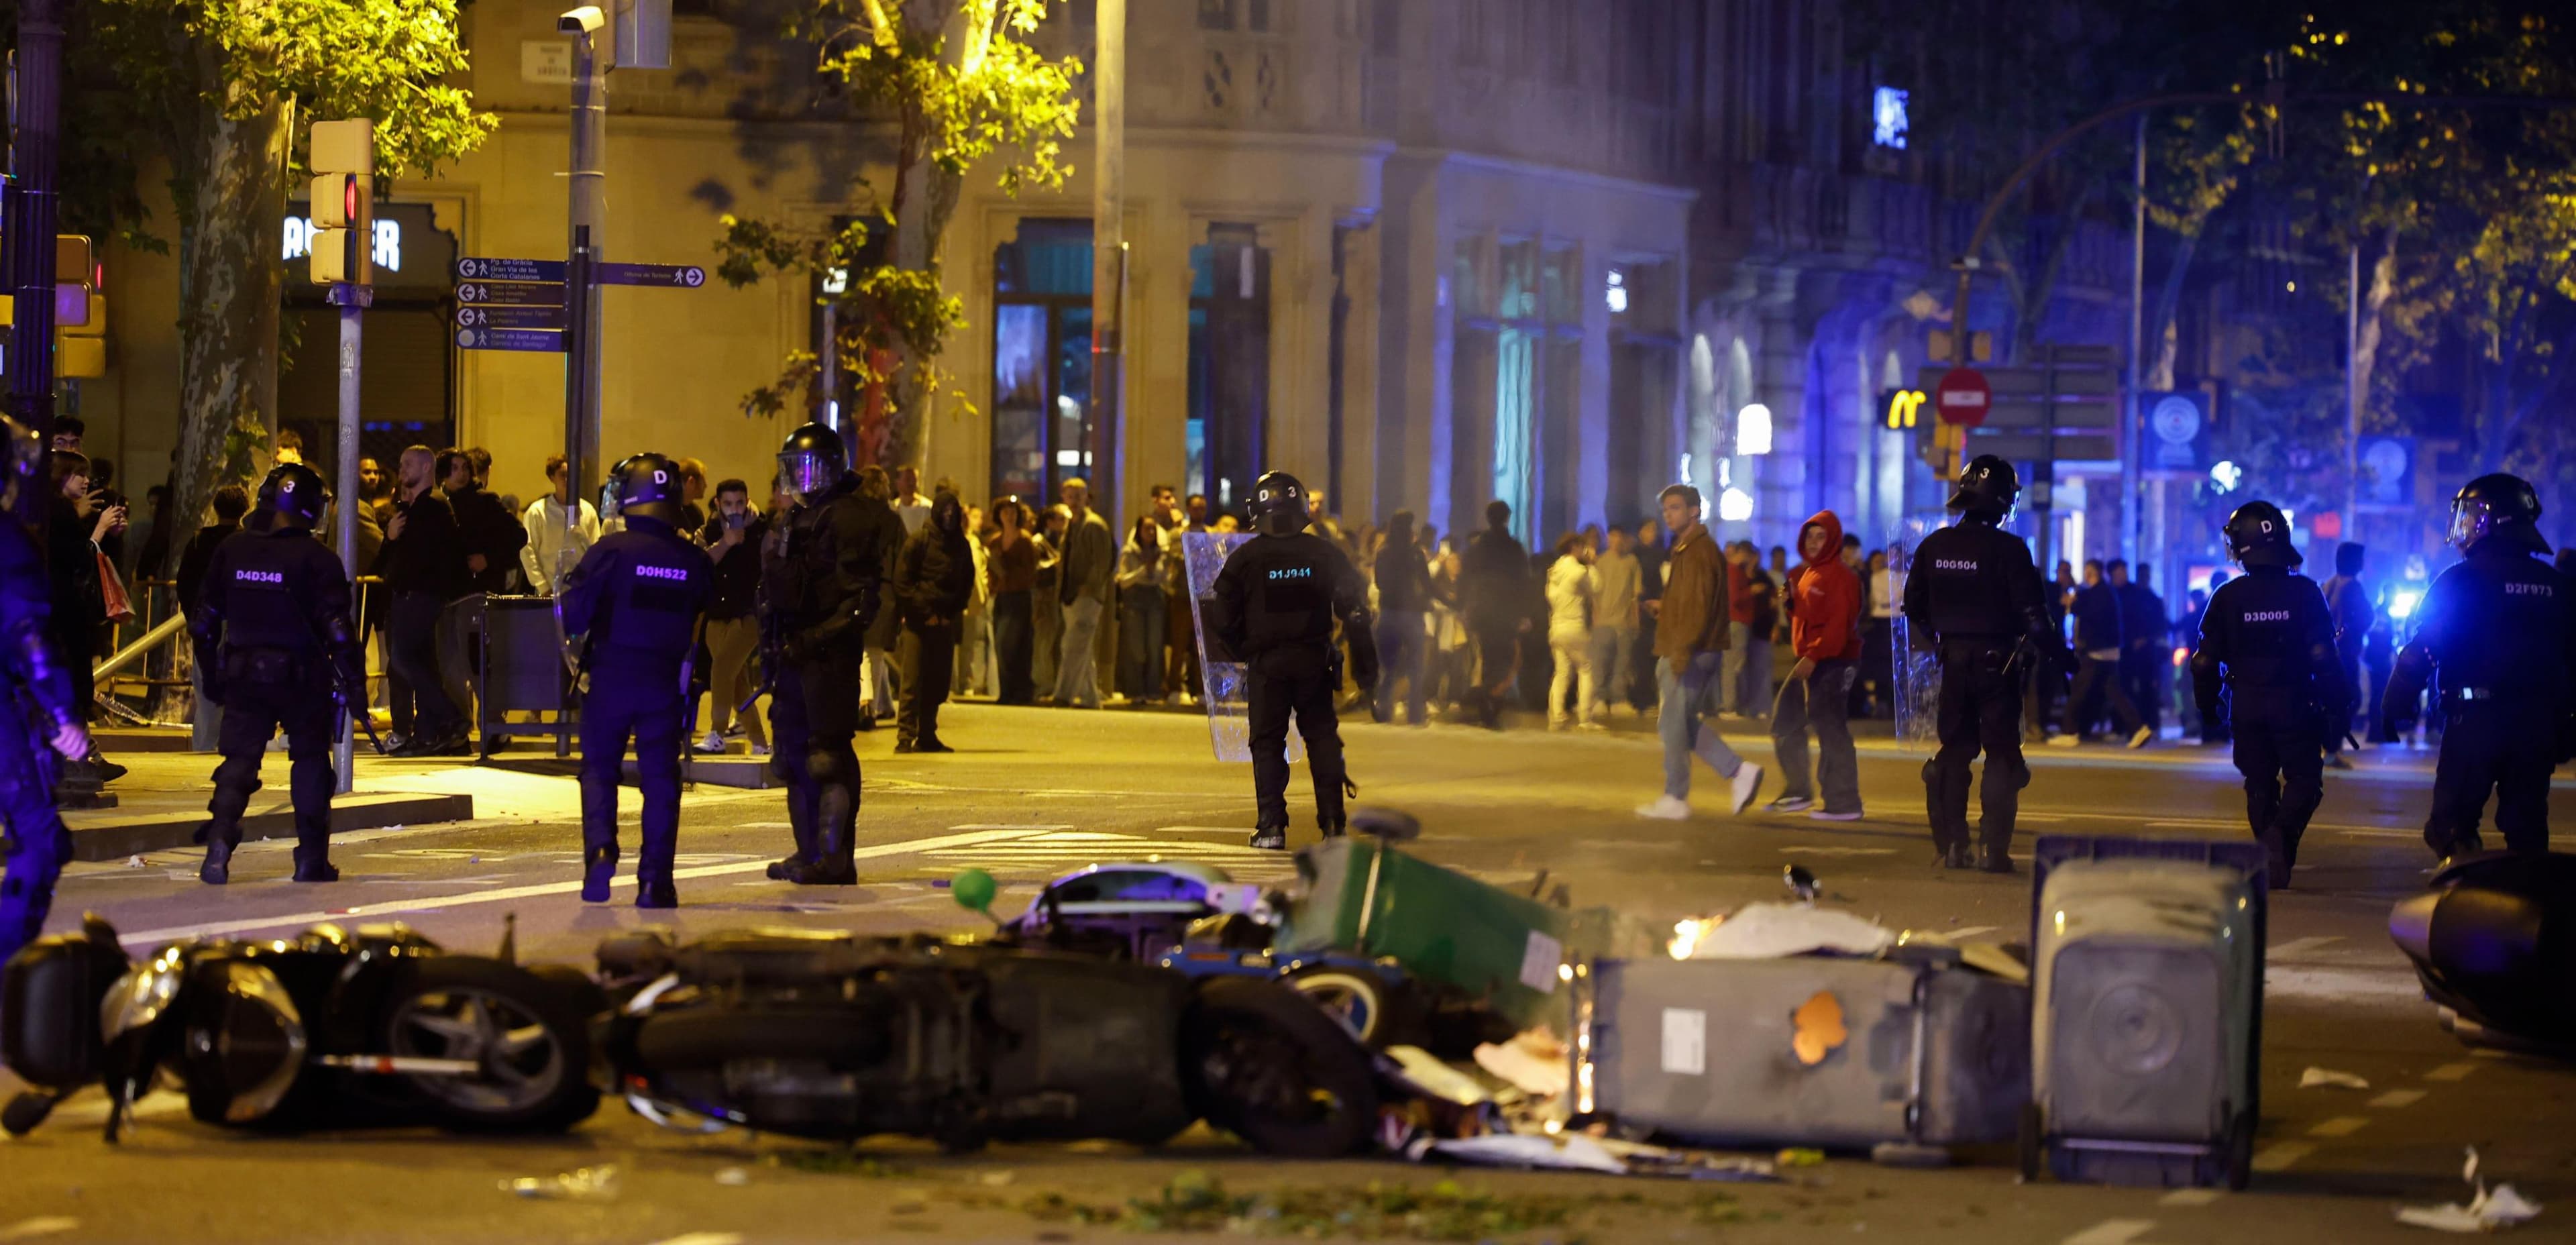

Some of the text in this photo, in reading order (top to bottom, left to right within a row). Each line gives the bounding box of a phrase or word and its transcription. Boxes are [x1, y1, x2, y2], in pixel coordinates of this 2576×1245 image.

[653, 470, 667, 484] D
[1980, 467, 1990, 479] 3
[283, 480, 295, 493] 3
[1287, 486, 1297, 498] 3
[1259, 489, 1269, 502] D
[2261, 520, 2273, 534] D
[236, 570, 282, 583] D4D348
